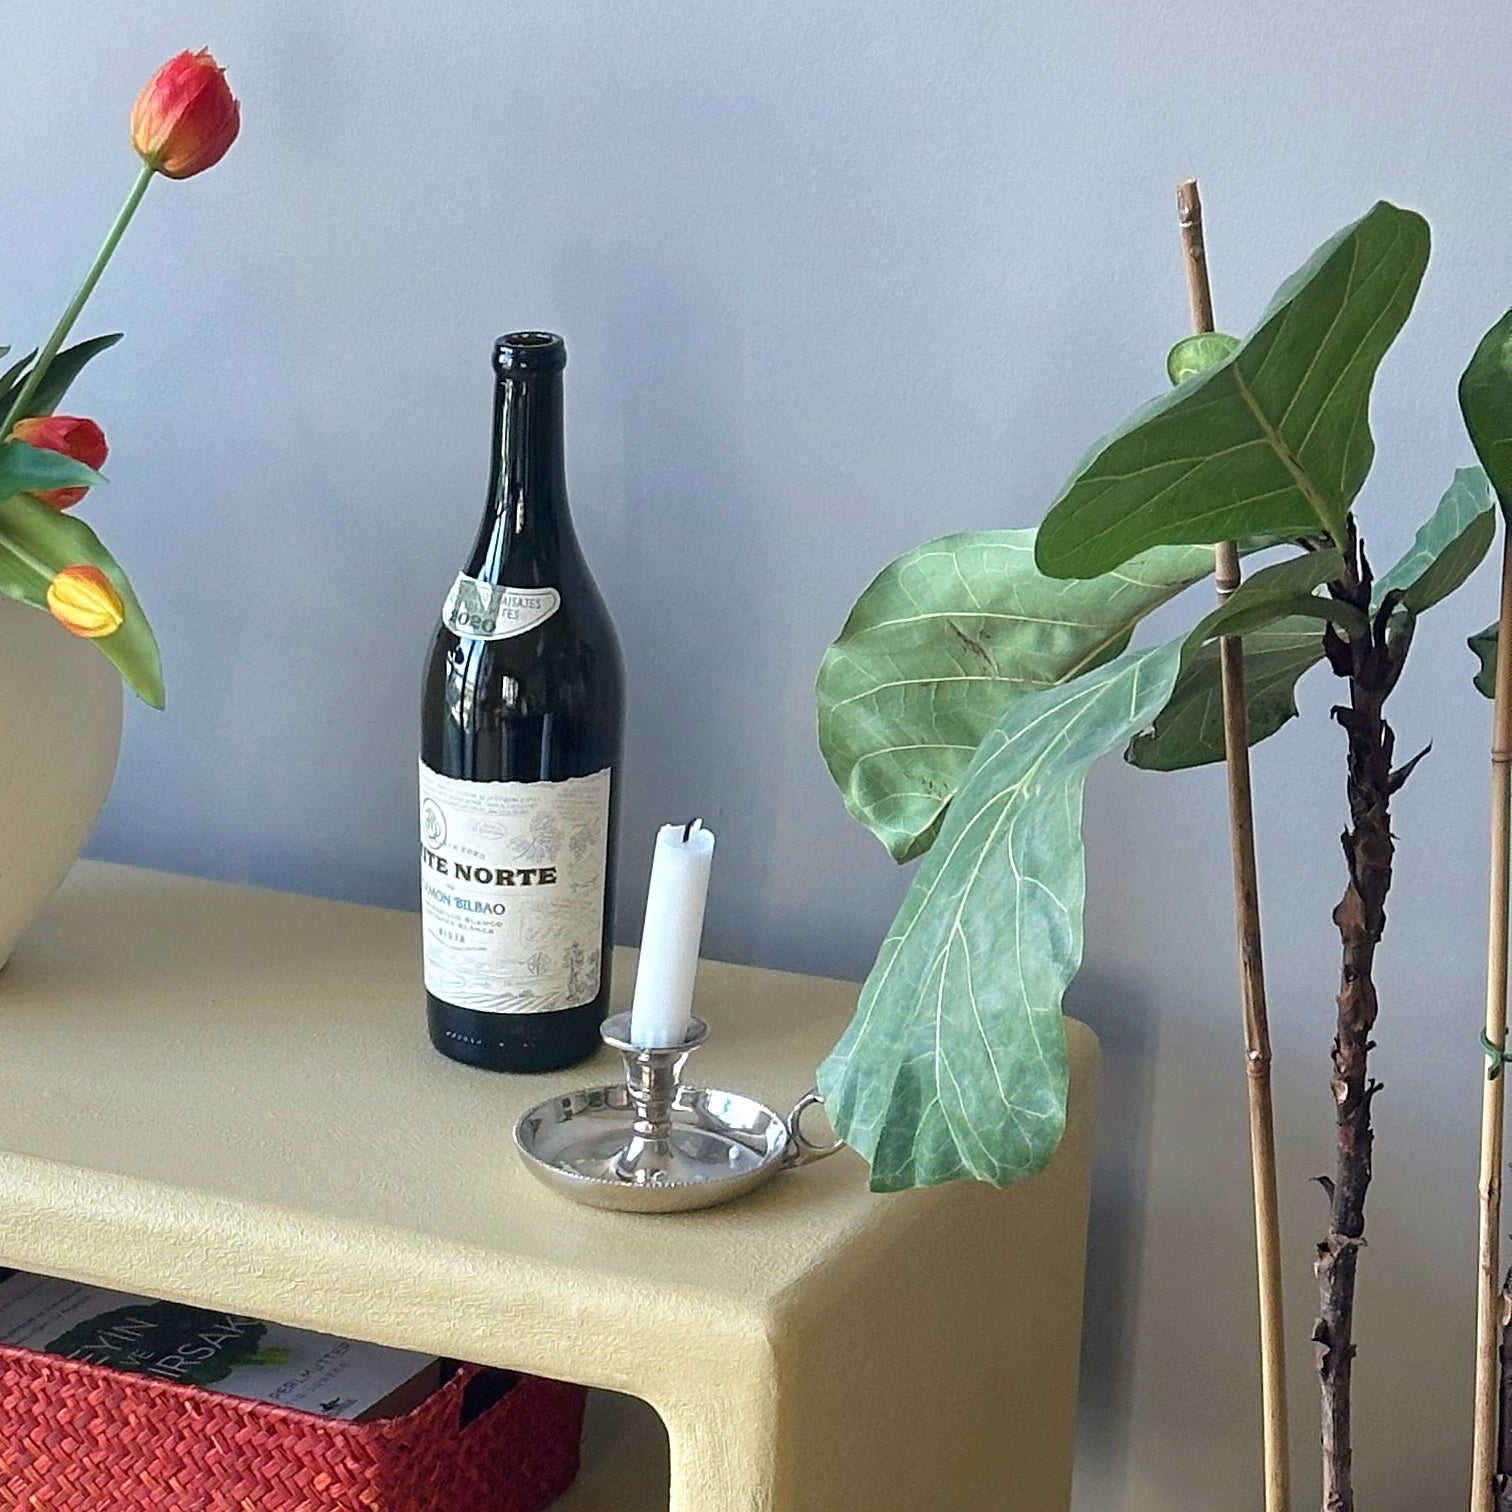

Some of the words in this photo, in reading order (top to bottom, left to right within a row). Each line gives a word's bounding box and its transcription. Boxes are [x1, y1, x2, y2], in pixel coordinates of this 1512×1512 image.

[421, 845, 449, 877] ITE
[453, 861, 558, 887] NORTE
[453, 896, 506, 916] BILBAO
[66, 1316, 159, 1366] EYİN
[119, 1349, 155, 1366] VE
[147, 1315, 261, 1379] IRSAK
